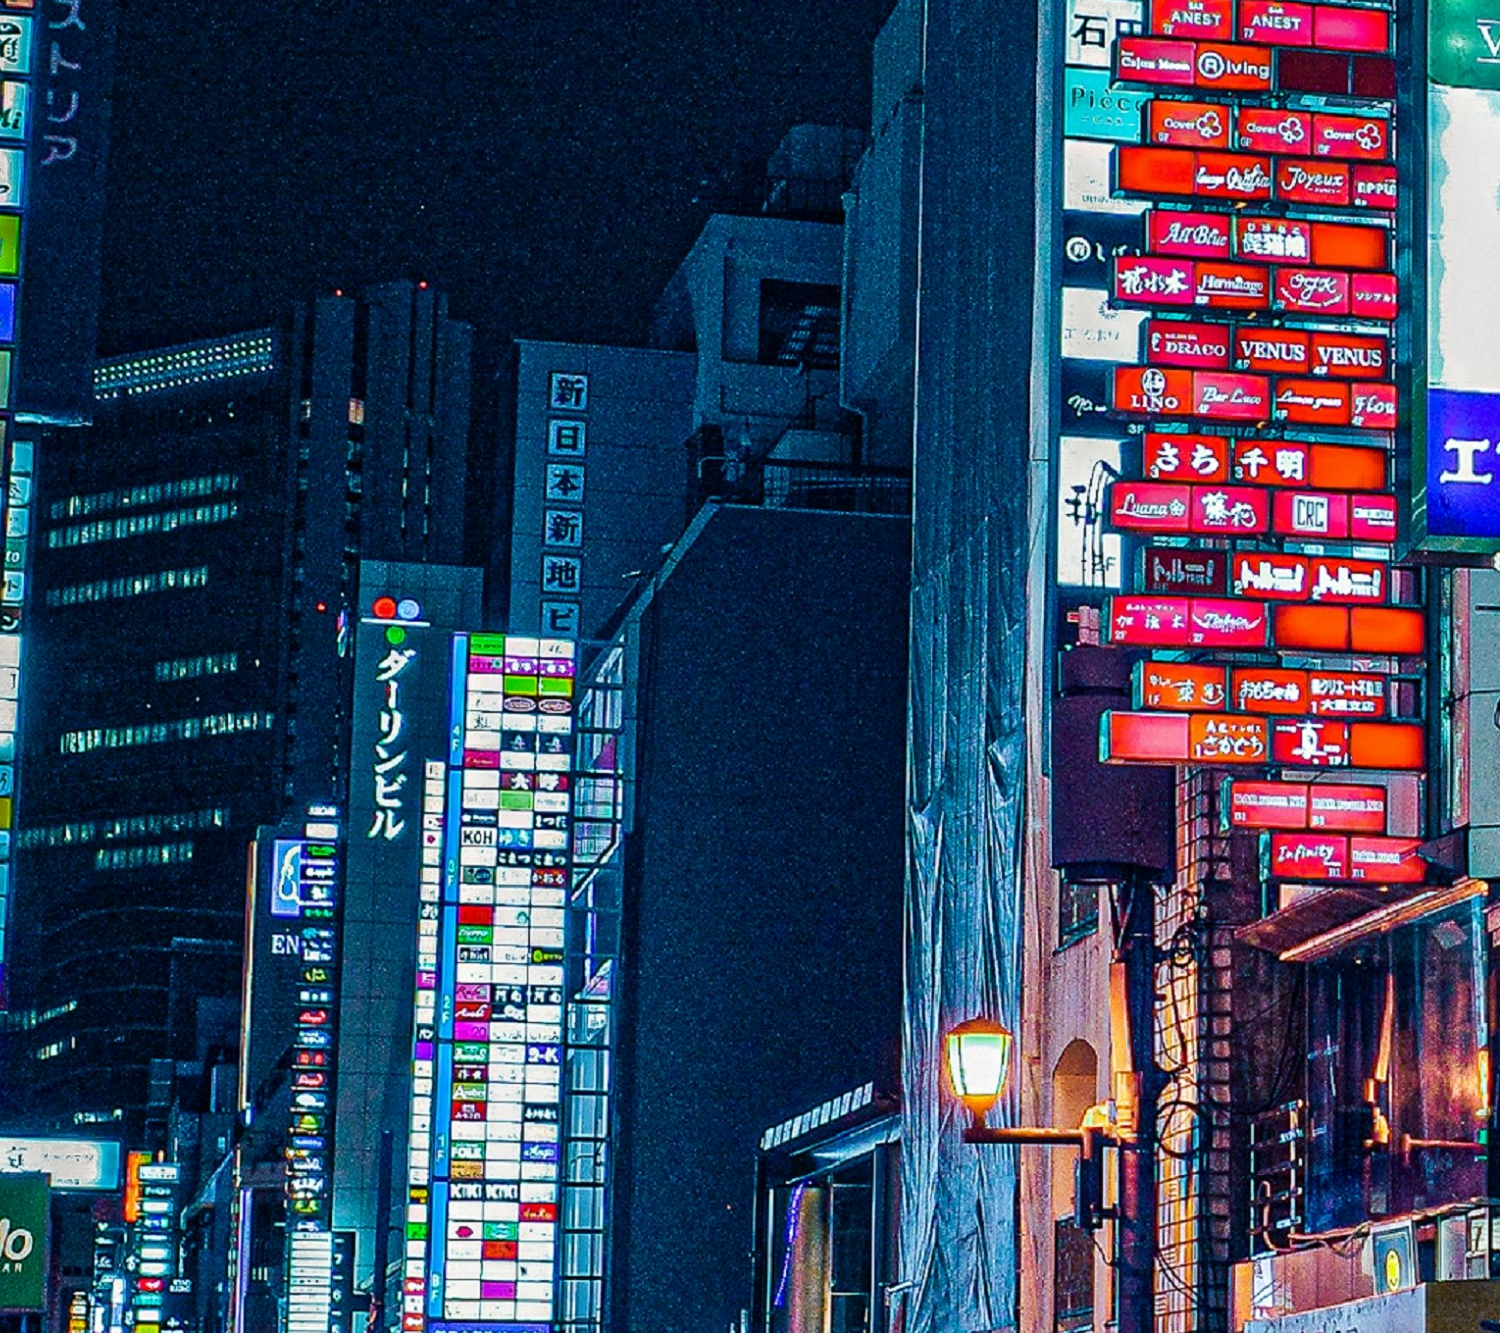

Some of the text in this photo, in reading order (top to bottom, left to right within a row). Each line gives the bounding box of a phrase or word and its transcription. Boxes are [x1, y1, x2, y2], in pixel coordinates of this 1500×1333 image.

[1171, 10, 1221, 27] ANEST
[1252, 14, 1301, 30] ANEST
[1164, 118, 1197, 130] Clover
[1246, 123, 1277, 135] Clover
[1324, 128, 1355, 141] Clover
[1281, 167, 1343, 191] Joyeux
[1165, 342, 1226, 357] DRACO
[1240, 340, 1306, 361] VENUS
[1317, 346, 1382, 367] VENUS
[1156, 443, 1219, 474] さち
[1240, 448, 1304, 478] 千明
[1116, 494, 1168, 517] Luana
[1295, 498, 1326, 527] CRC
[367, 648, 417, 841] ダーリンビル
[463, 828, 493, 845] KOH
[1278, 845, 1334, 862] Infinity
